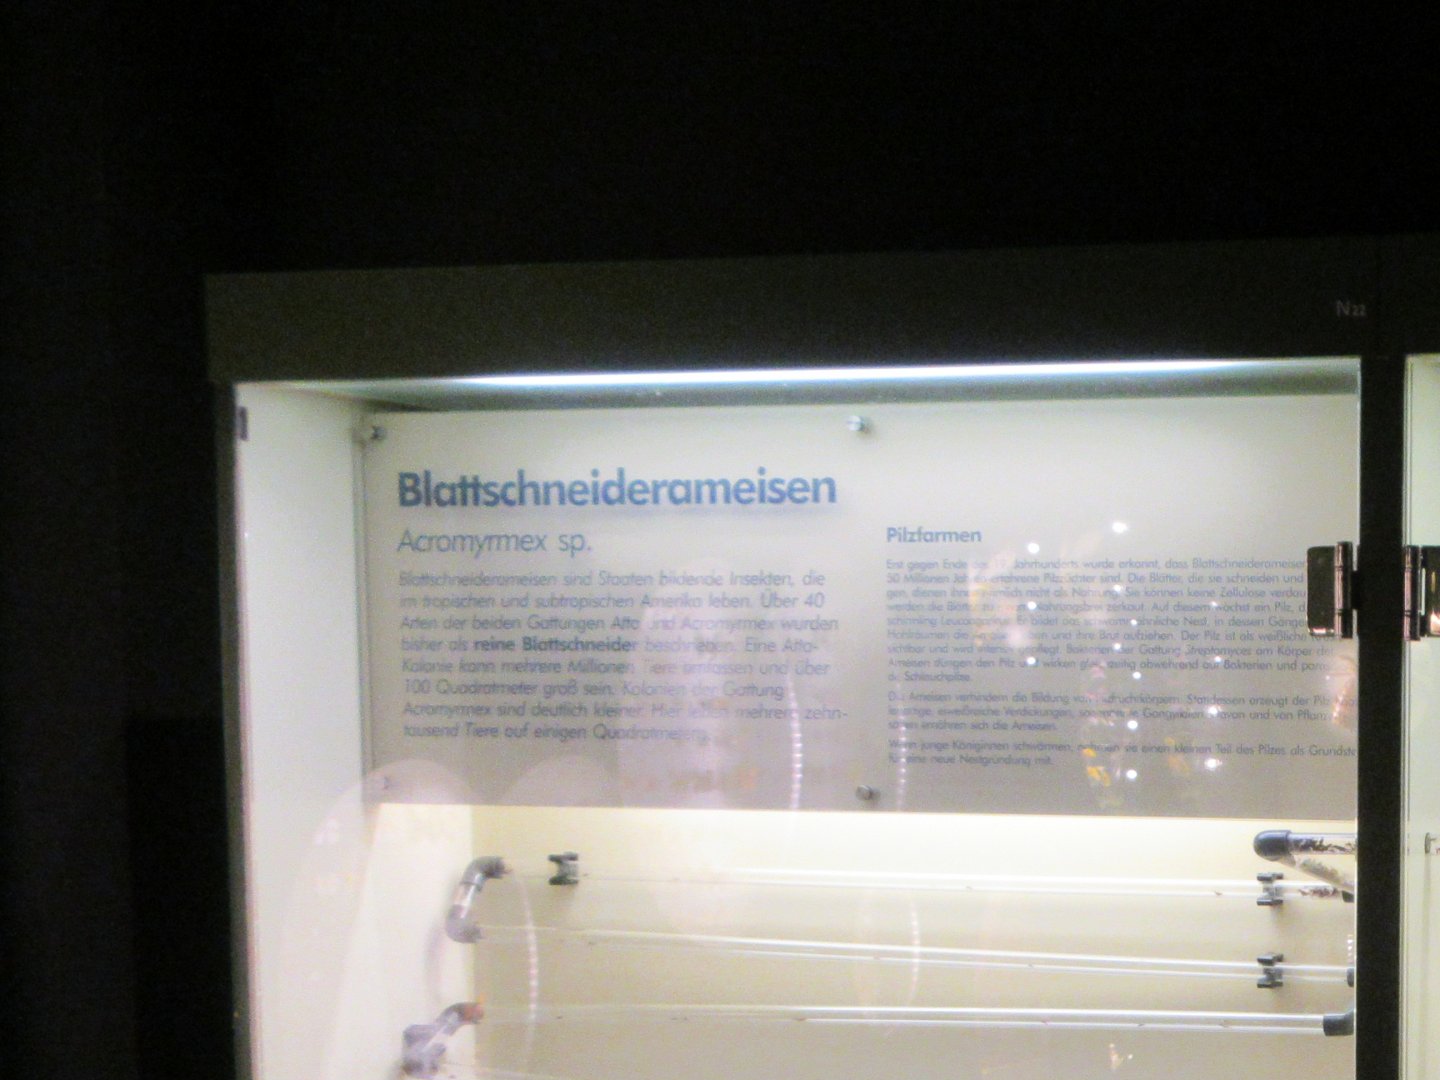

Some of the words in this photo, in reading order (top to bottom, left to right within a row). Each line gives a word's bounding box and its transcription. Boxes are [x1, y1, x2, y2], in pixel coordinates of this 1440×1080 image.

[398, 466, 837, 507] Blattschneiderameisen
[397, 528, 547, 559] Acromyrmex
[558, 533, 592, 558] sp.
[887, 526, 982, 543] Pilzfarmen
